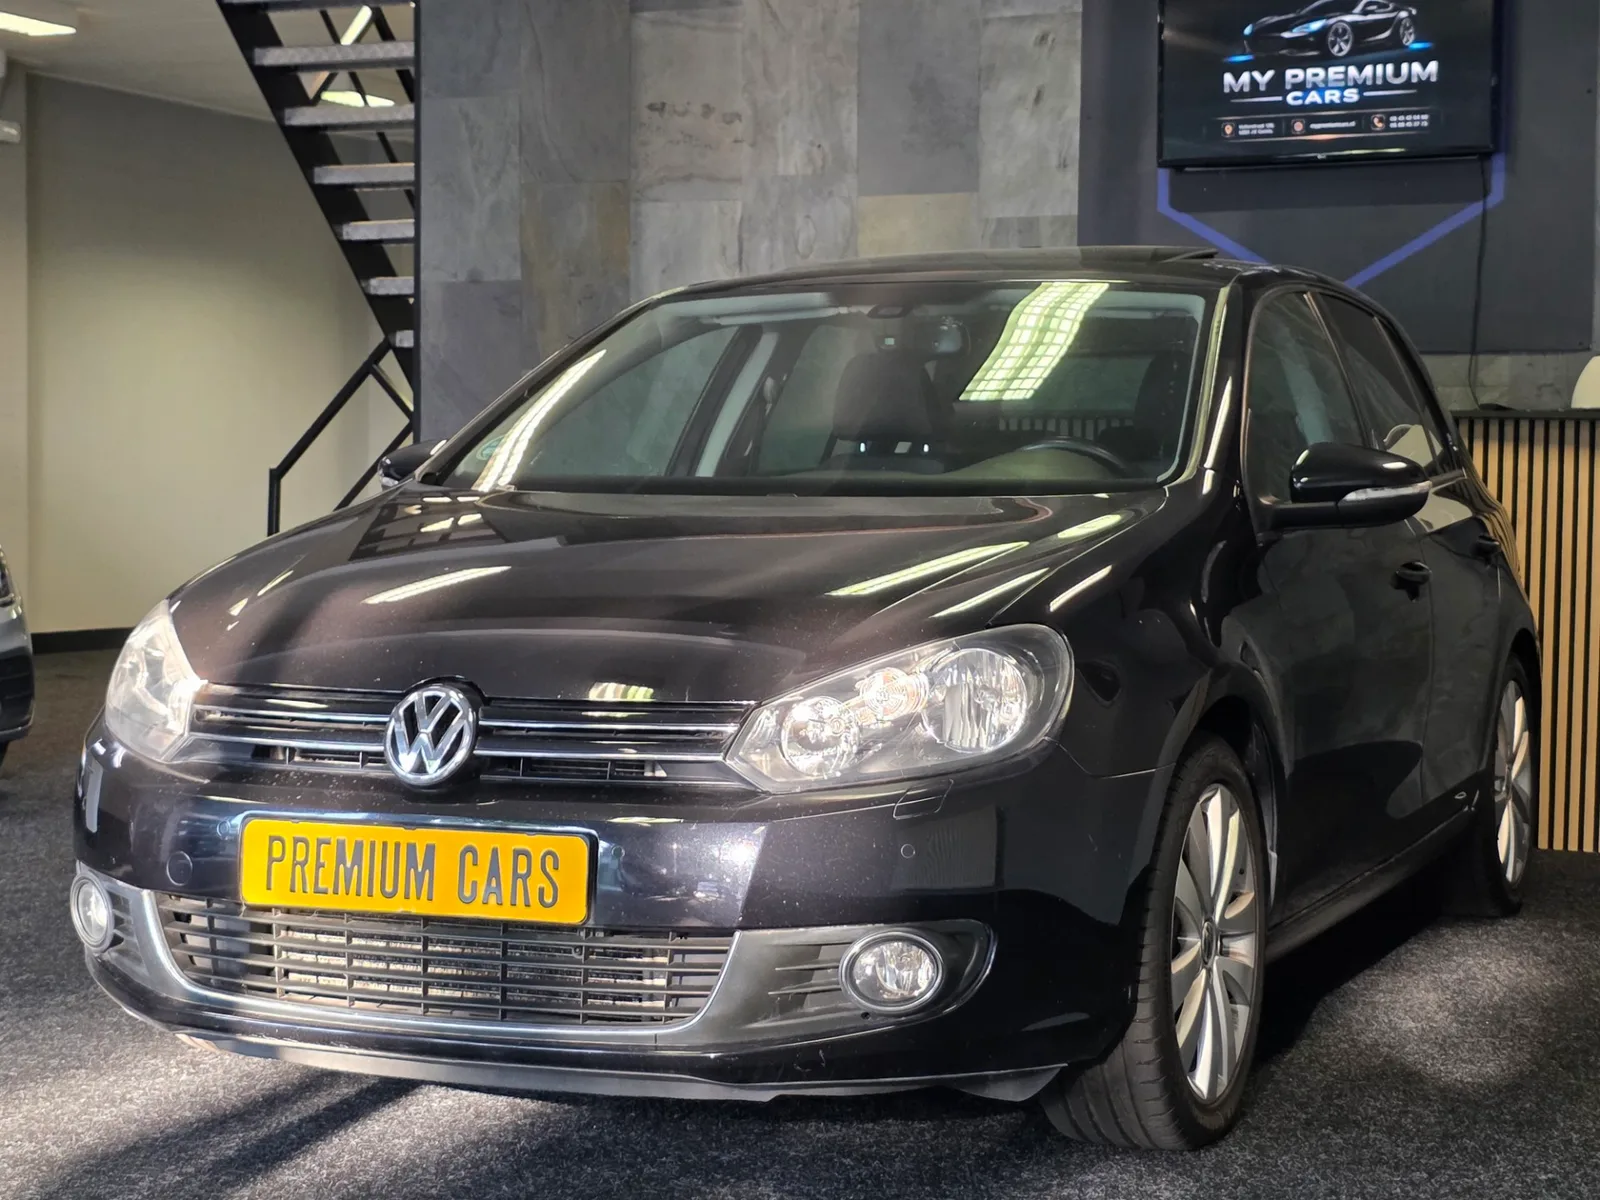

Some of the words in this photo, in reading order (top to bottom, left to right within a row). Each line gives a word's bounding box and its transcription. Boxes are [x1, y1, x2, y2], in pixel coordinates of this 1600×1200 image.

[1223, 69, 1275, 94] MY
[1285, 60, 1439, 89] PREMIUM
[1286, 88, 1360, 106] CARS
[266, 834, 437, 901] PREMIUM
[457, 843, 561, 909] CARS
